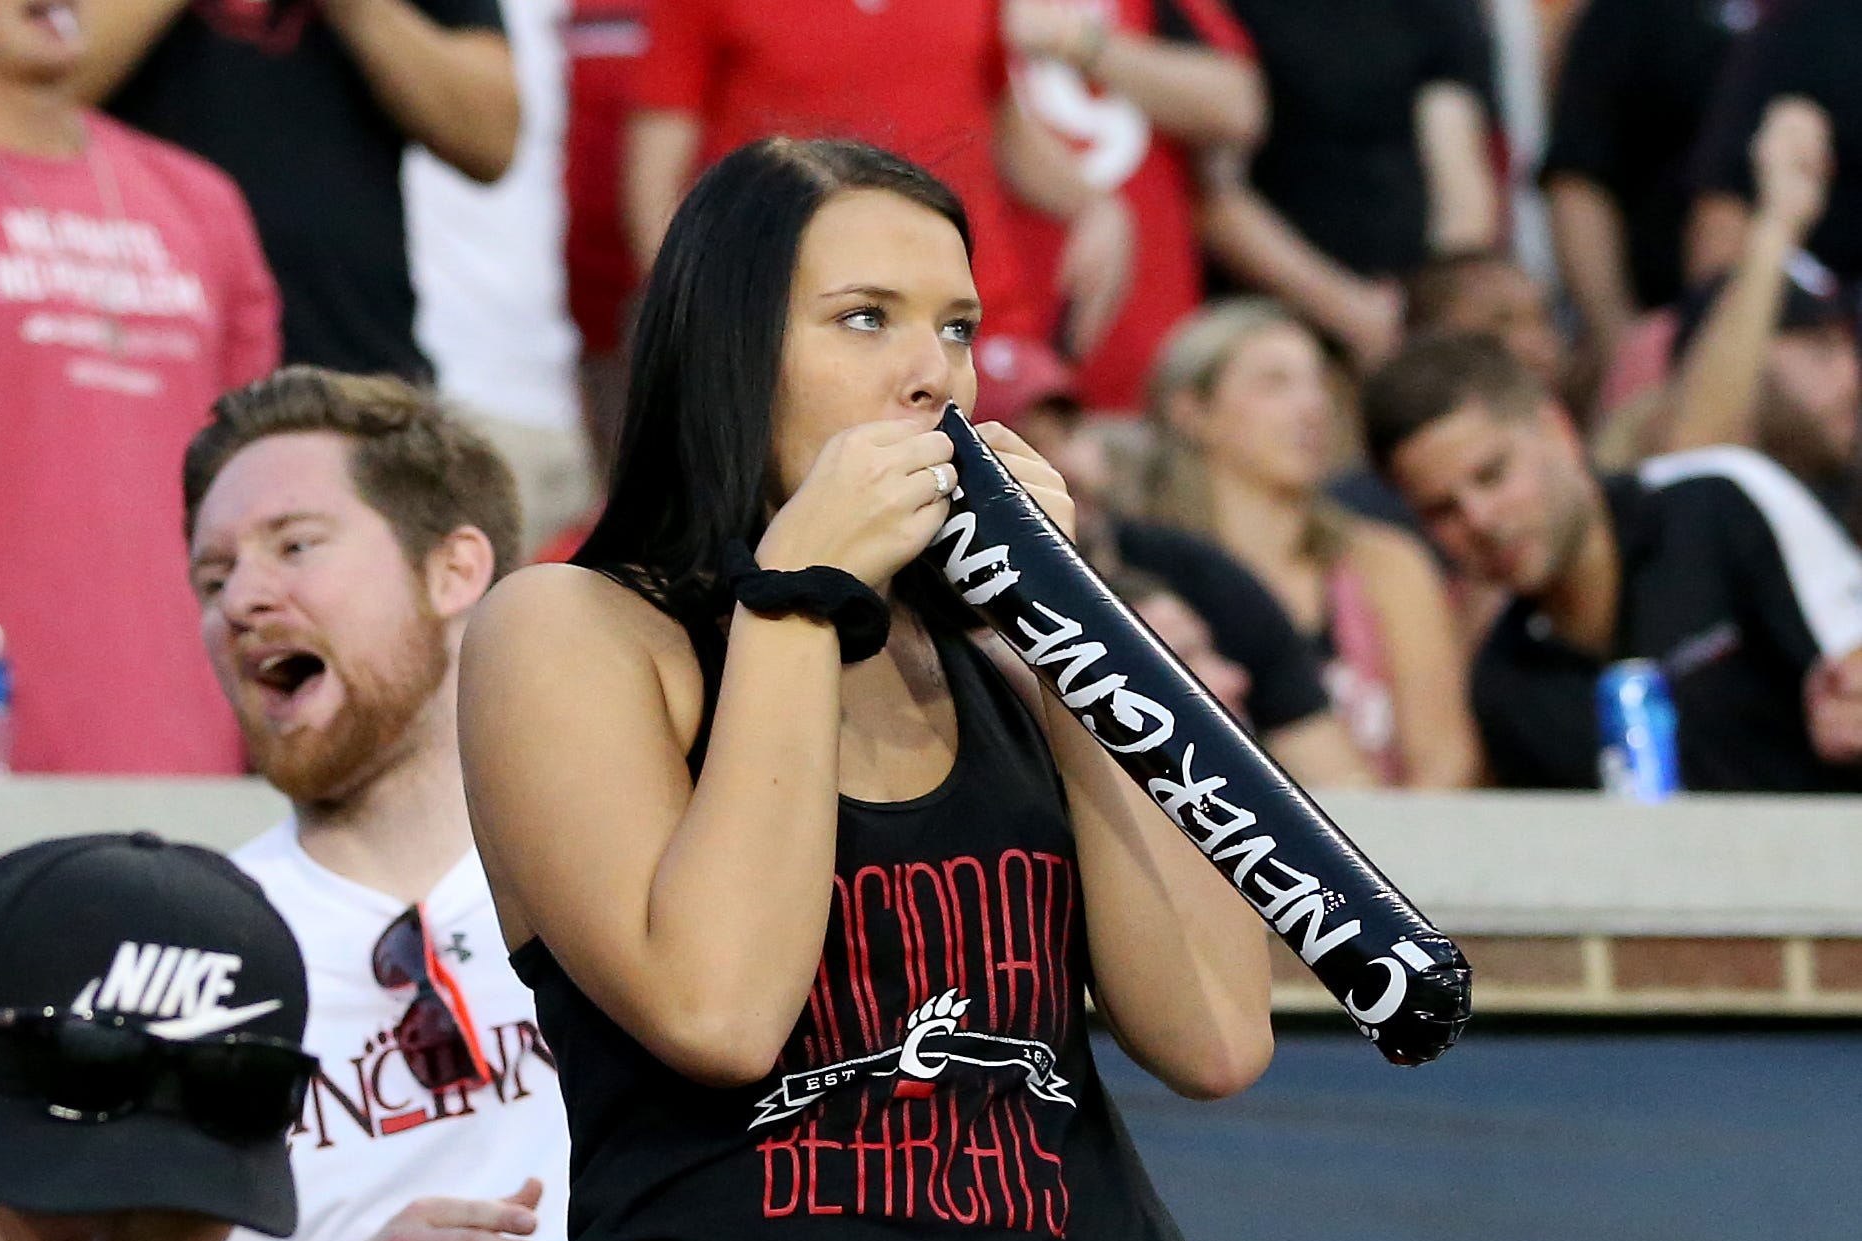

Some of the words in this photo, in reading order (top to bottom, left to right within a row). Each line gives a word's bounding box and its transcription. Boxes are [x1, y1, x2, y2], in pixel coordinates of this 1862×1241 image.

[931, 512, 1021, 606] IN
[1017, 600, 1176, 754] GIVE
[1148, 743, 1361, 966] NEVER
[98, 940, 243, 1020] NIKE
[806, 1069, 857, 1091] EST
[756, 1090, 1070, 1240] BEARCATS
